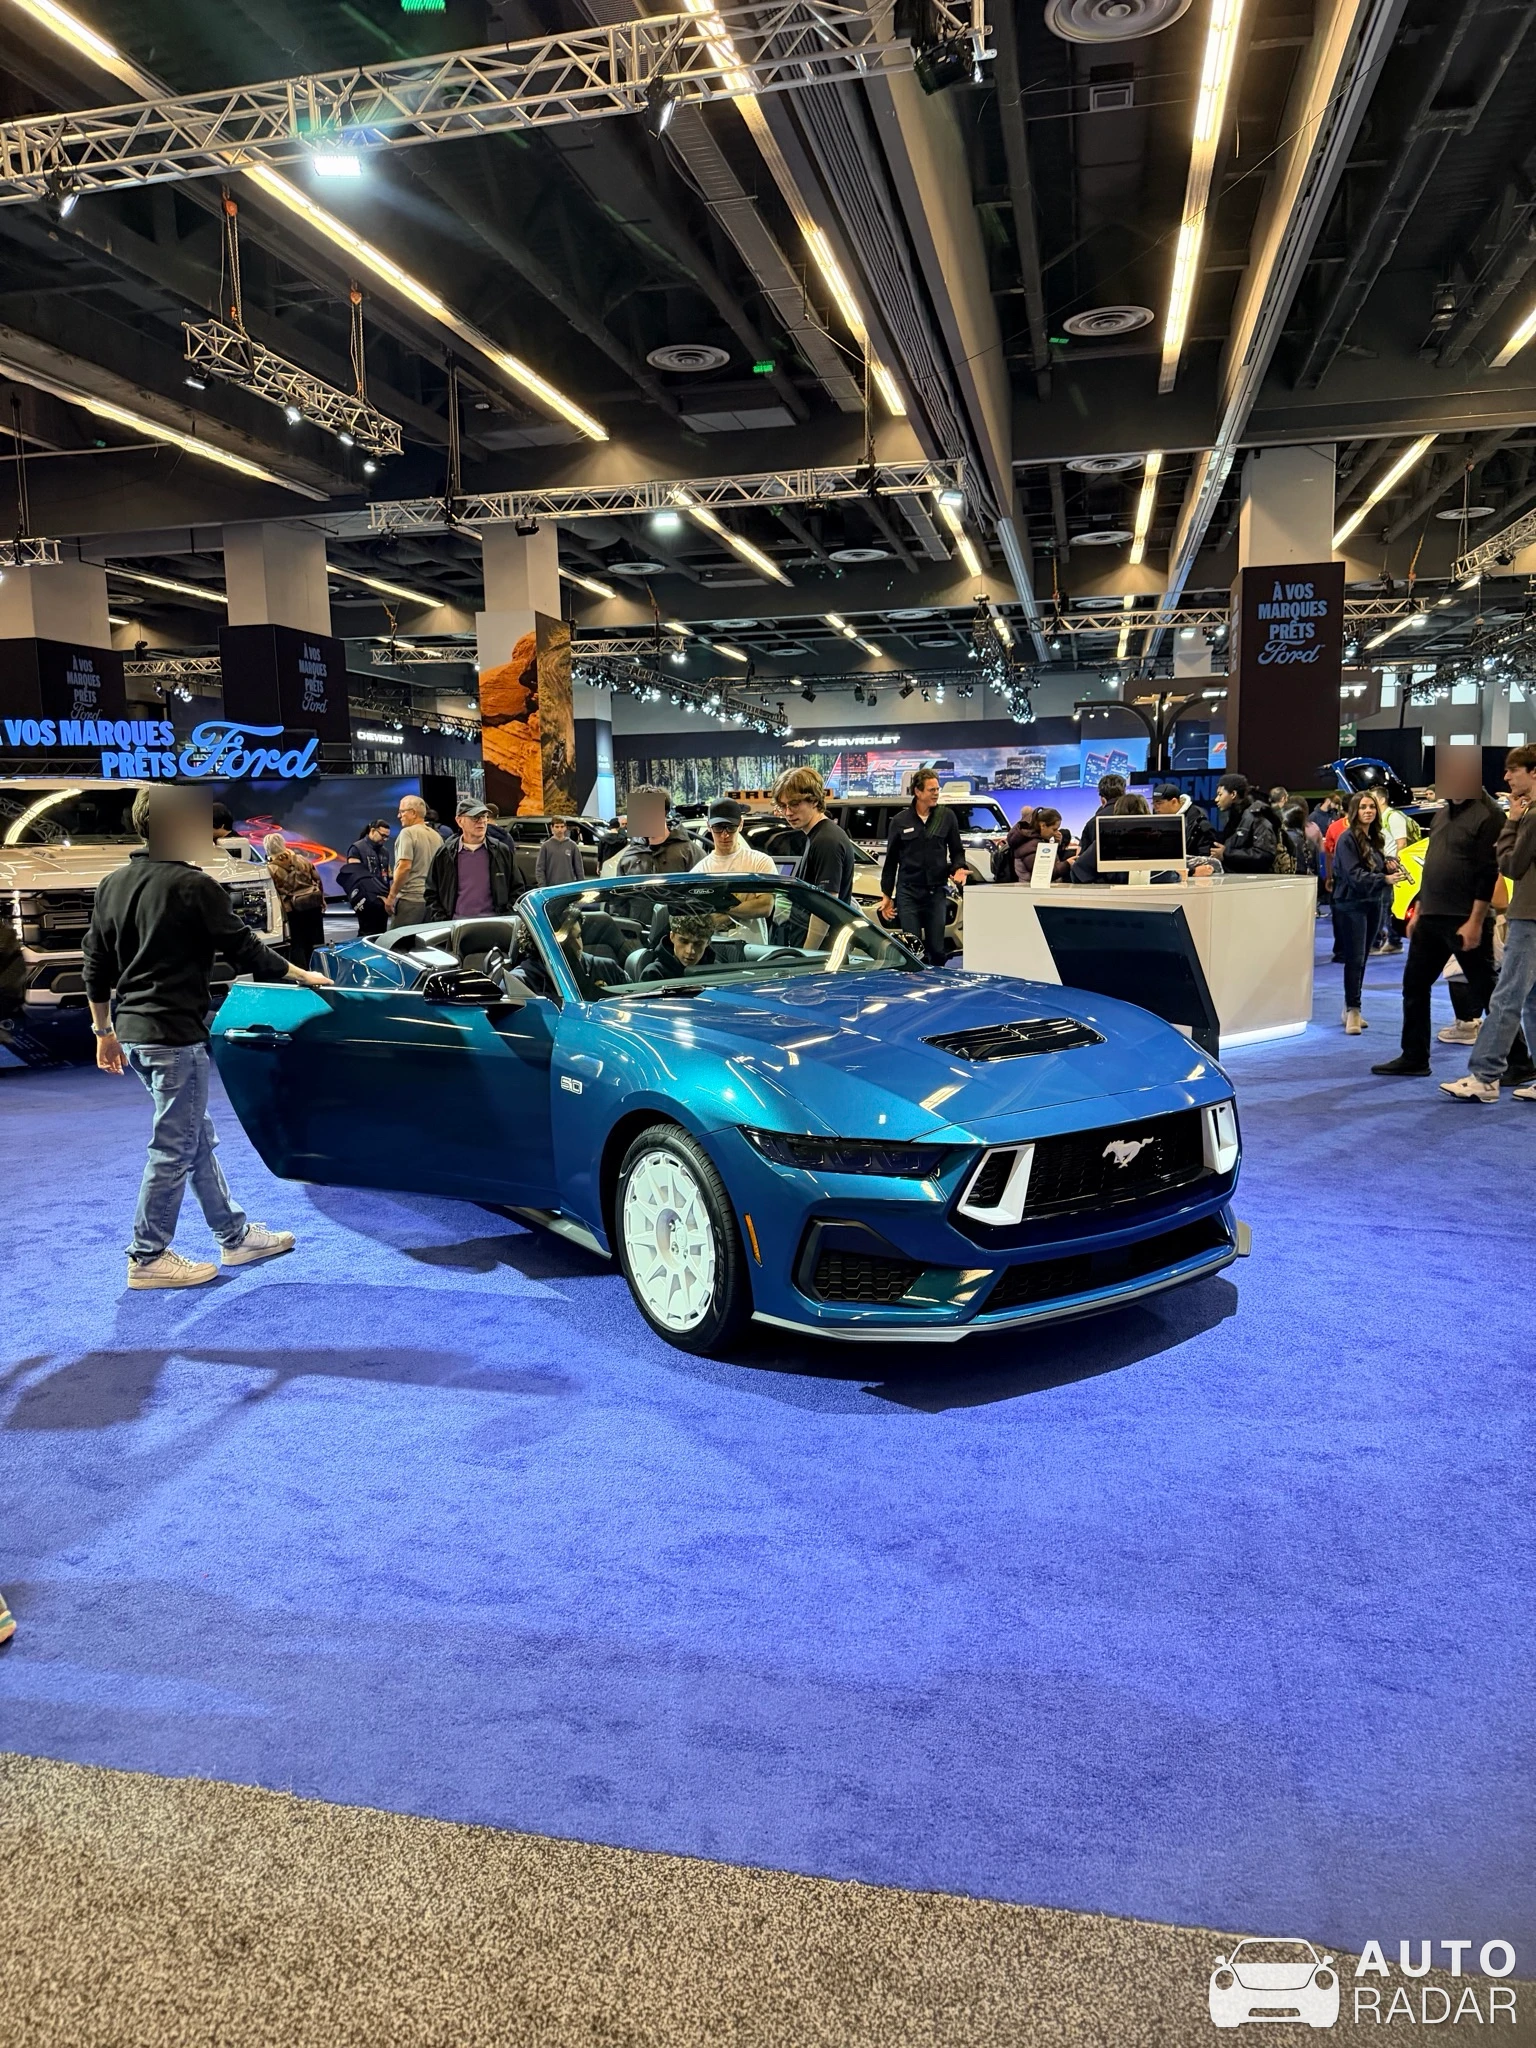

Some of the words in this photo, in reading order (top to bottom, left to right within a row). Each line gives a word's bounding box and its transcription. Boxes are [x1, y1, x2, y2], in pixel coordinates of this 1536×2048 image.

[1273, 581, 1283, 601] À
[1286, 583, 1314, 600] VOS
[1258, 600, 1328, 621] MARQUES
[1269, 620, 1315, 640] PRÊTS
[308, 646, 321, 662] VOS
[1257, 639, 1322, 665] Ford
[78, 658, 93, 673] VOS
[298, 658, 328, 679] MARQUES
[66, 671, 101, 690] MARQUES
[70, 701, 102, 721] Ford
[302, 691, 328, 714] Ford
[4, 719, 57, 747] VOS
[59, 720, 176, 751] MARQUES
[356, 731, 404, 745] CHEVROLET
[817, 735, 901, 747] CHEVROLET
[178, 720, 320, 779] Ford
[101, 746, 178, 778] PRÊTS
